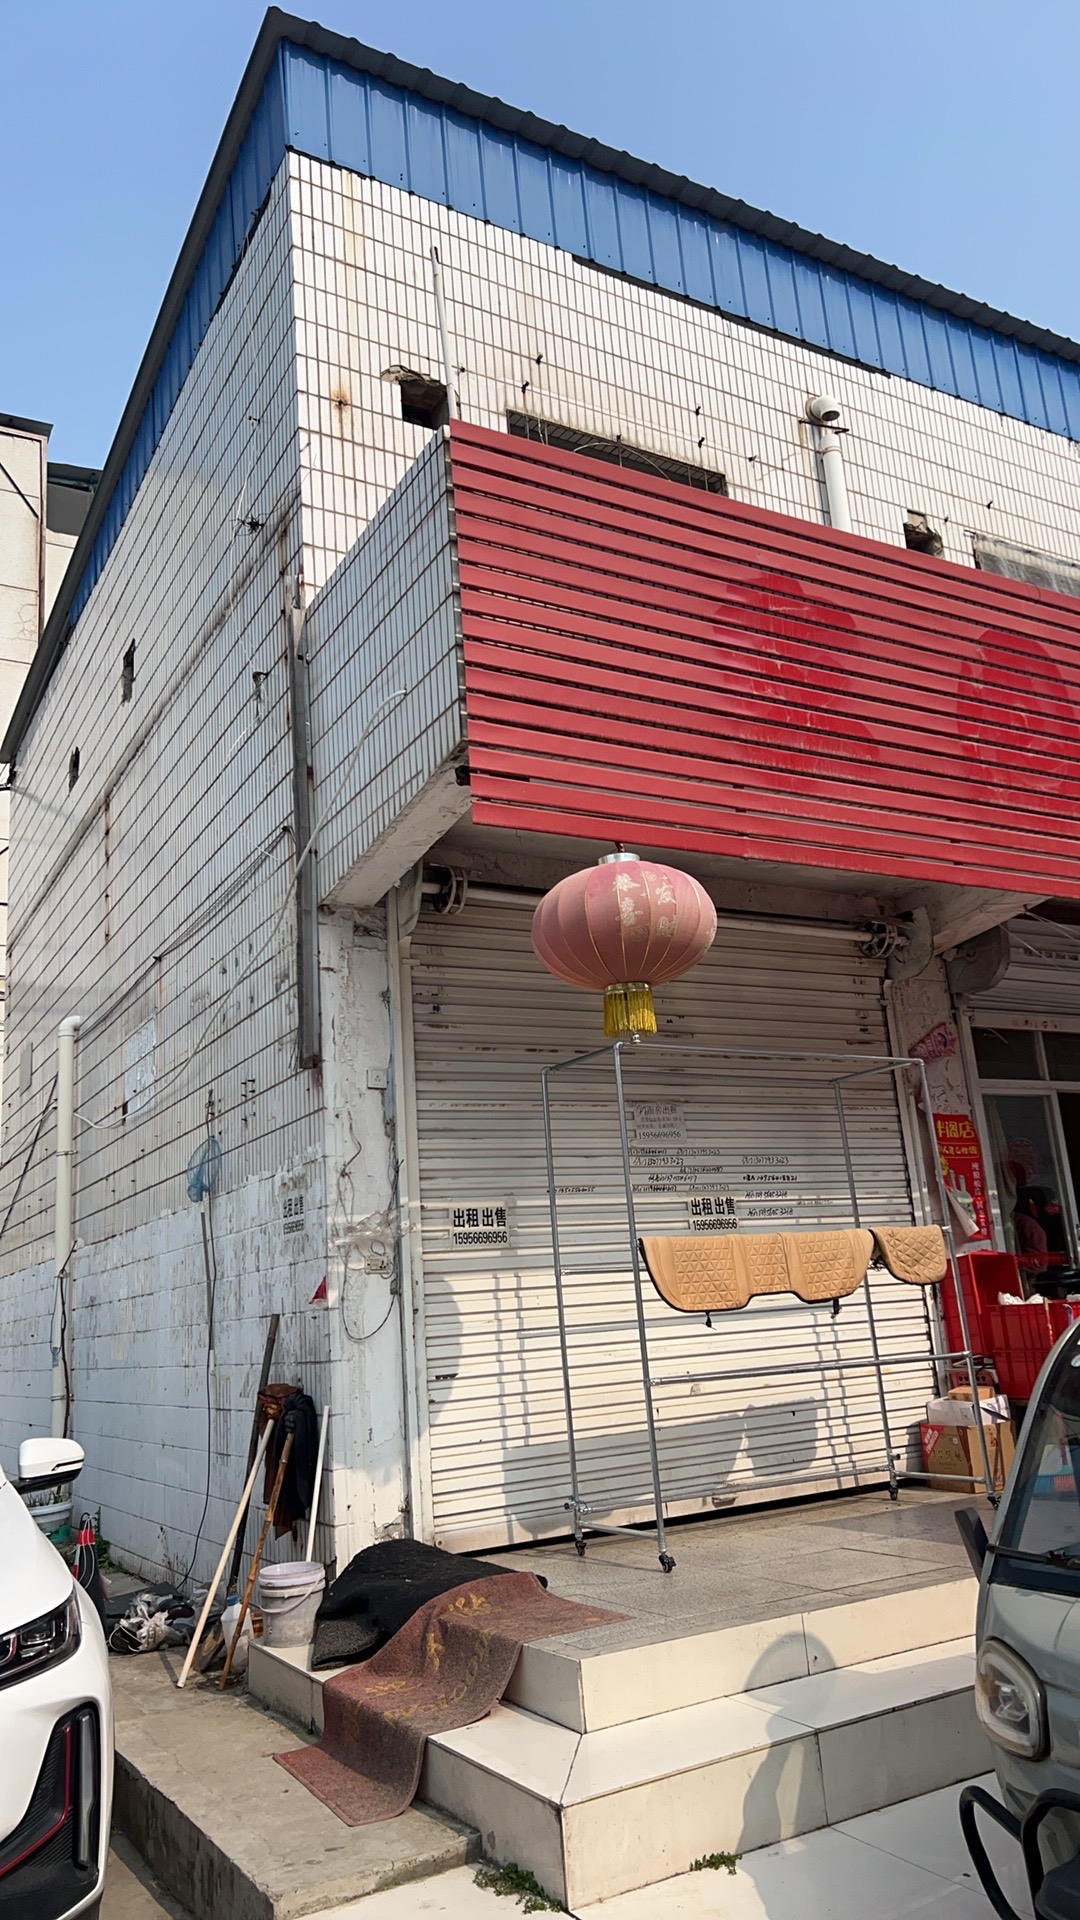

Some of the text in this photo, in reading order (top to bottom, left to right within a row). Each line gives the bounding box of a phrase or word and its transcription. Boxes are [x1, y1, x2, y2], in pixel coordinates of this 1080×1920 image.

[639, 1131, 682, 1140] 15956696956
[691, 1196, 736, 1216] 出租出售
[453, 1207, 507, 1228] 出租出售
[692, 1218, 738, 1231] 15956696956
[453, 1231, 508, 1245] 15956696956
